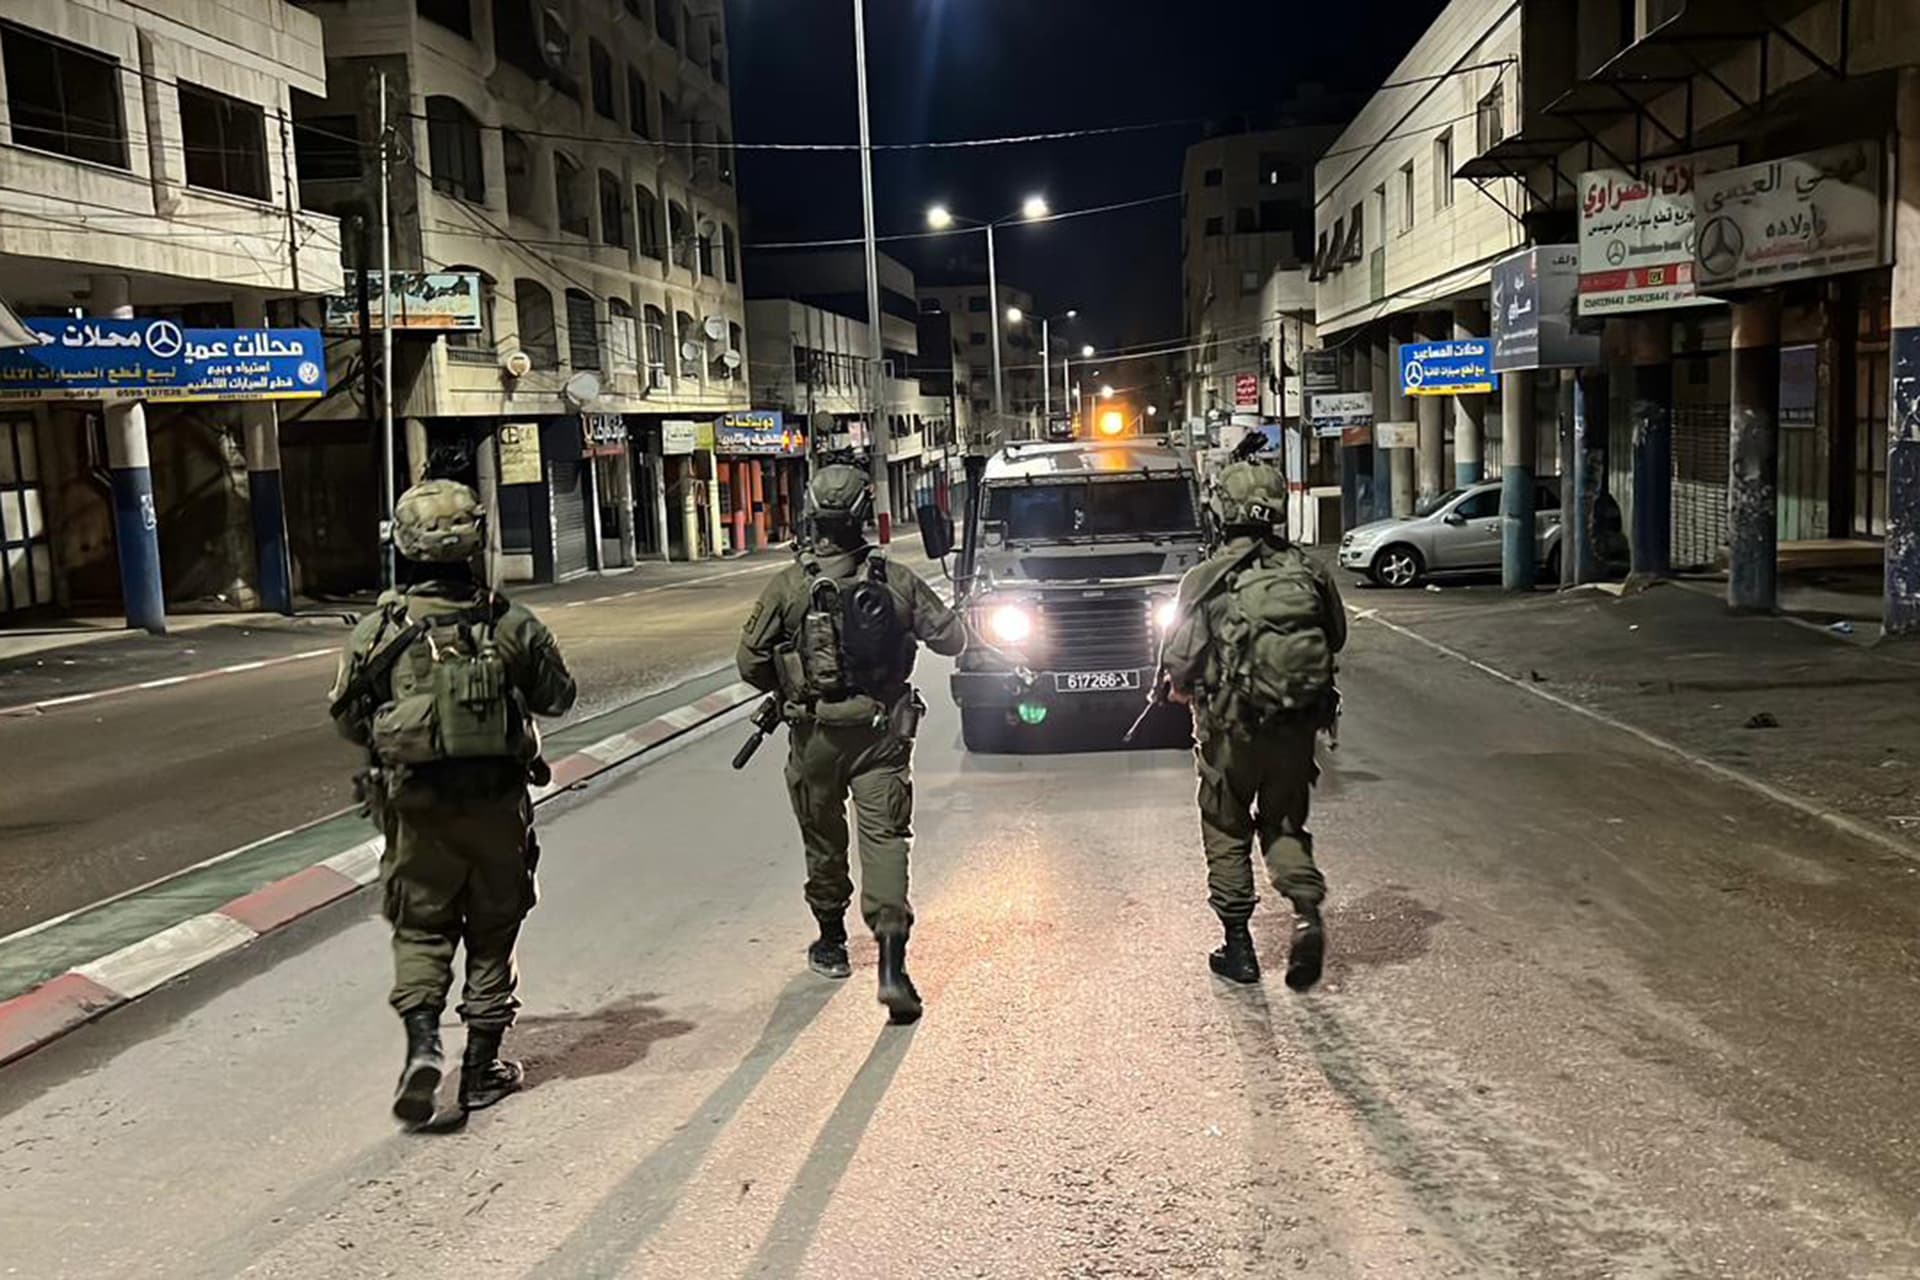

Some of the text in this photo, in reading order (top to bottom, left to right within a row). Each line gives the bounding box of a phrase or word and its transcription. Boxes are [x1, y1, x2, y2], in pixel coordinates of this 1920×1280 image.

[61, 323, 142, 348] محلات
[233, 331, 304, 357] محلات
[1454, 343, 1484, 357] محلات
[107, 362, 142, 384] قطع
